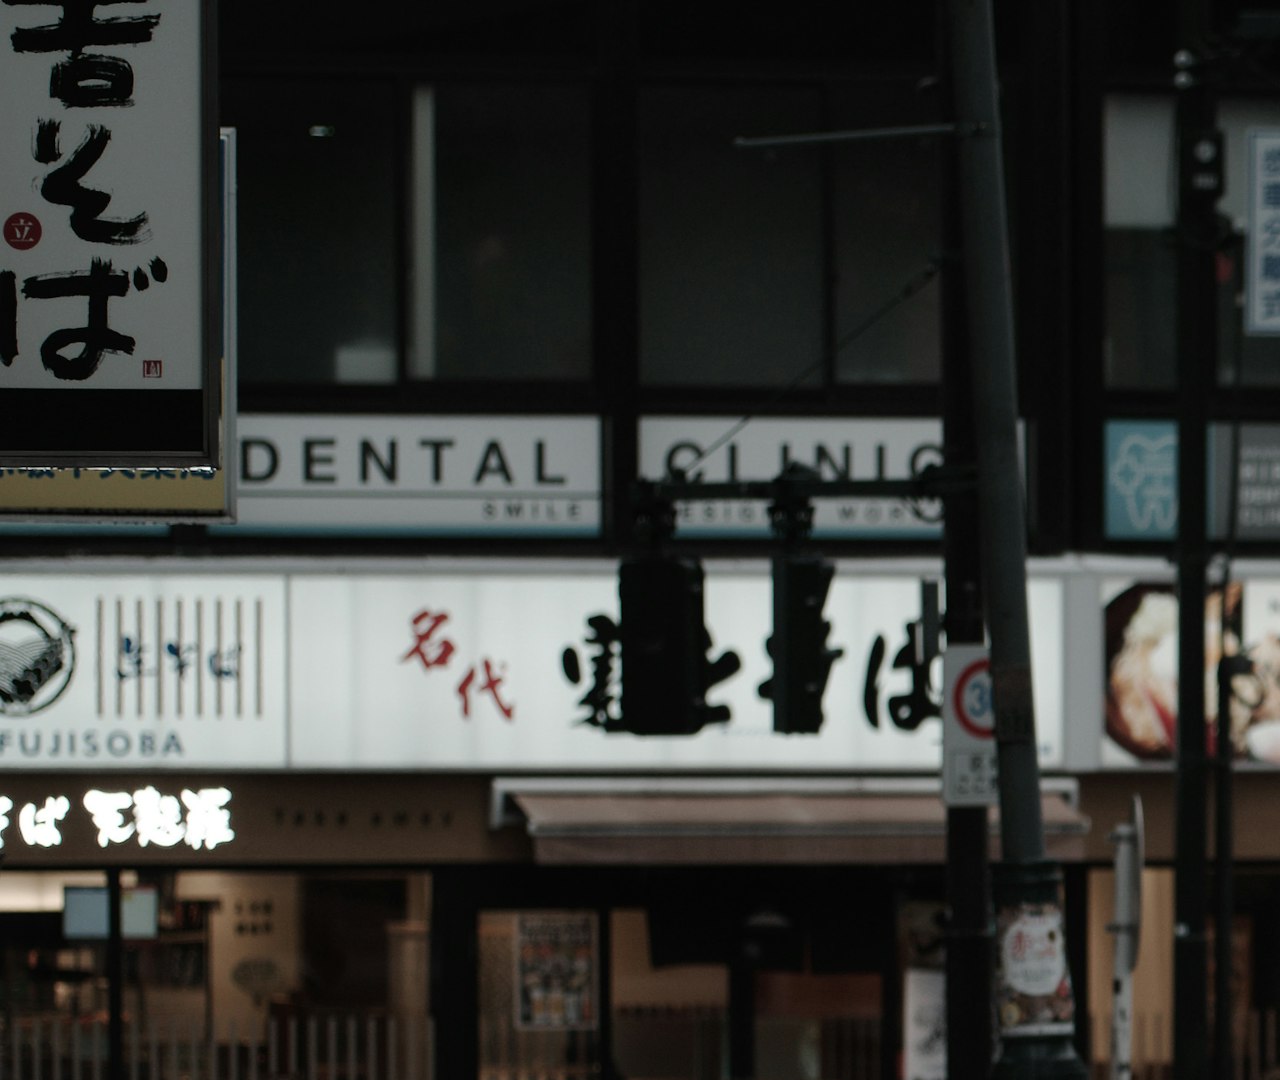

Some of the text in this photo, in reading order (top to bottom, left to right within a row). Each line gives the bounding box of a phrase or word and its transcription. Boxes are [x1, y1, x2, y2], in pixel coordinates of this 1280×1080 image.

[240, 438, 568, 485] DENTAL
[483, 503, 581, 521] SMILE
[400, 610, 515, 722] 名代
